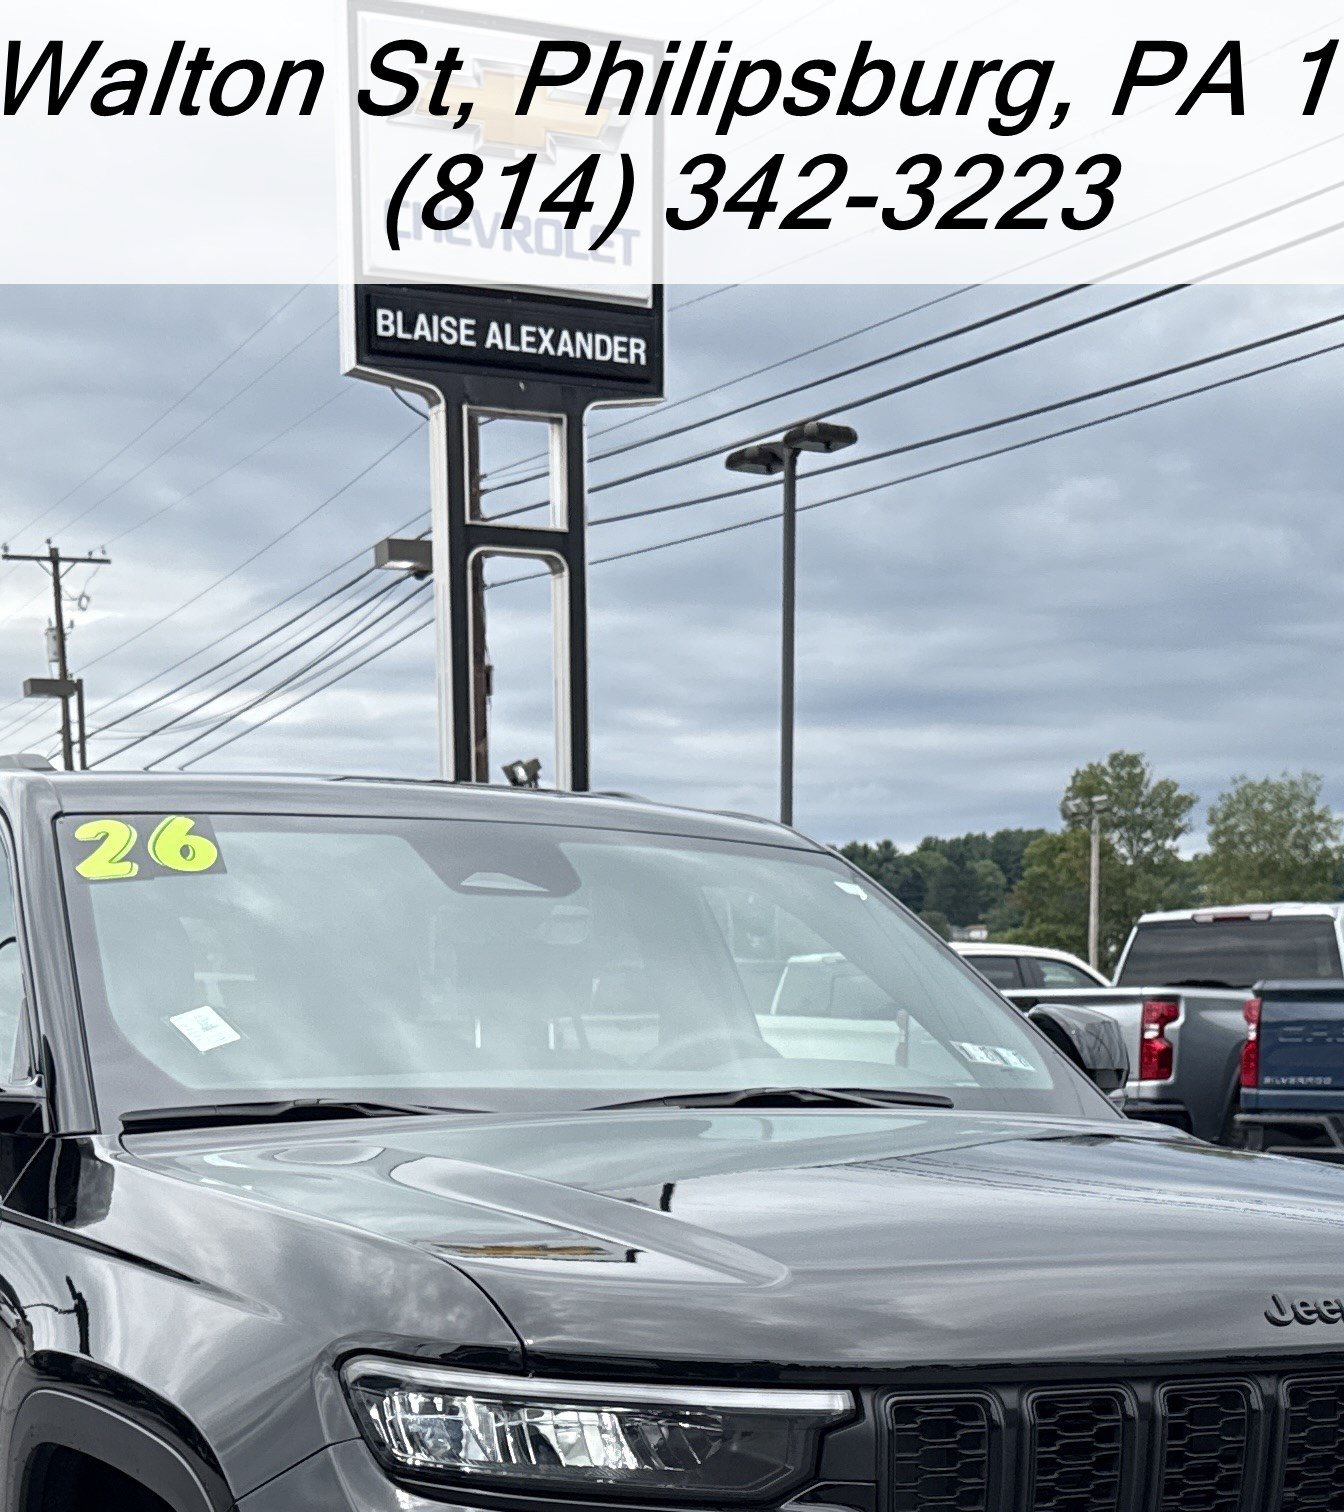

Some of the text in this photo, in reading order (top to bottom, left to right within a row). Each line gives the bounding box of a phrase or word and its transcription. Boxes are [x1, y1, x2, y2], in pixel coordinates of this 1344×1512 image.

[375, 308, 647, 366] BLAISE ALEXANDER
[74, 815, 218, 880] 26
